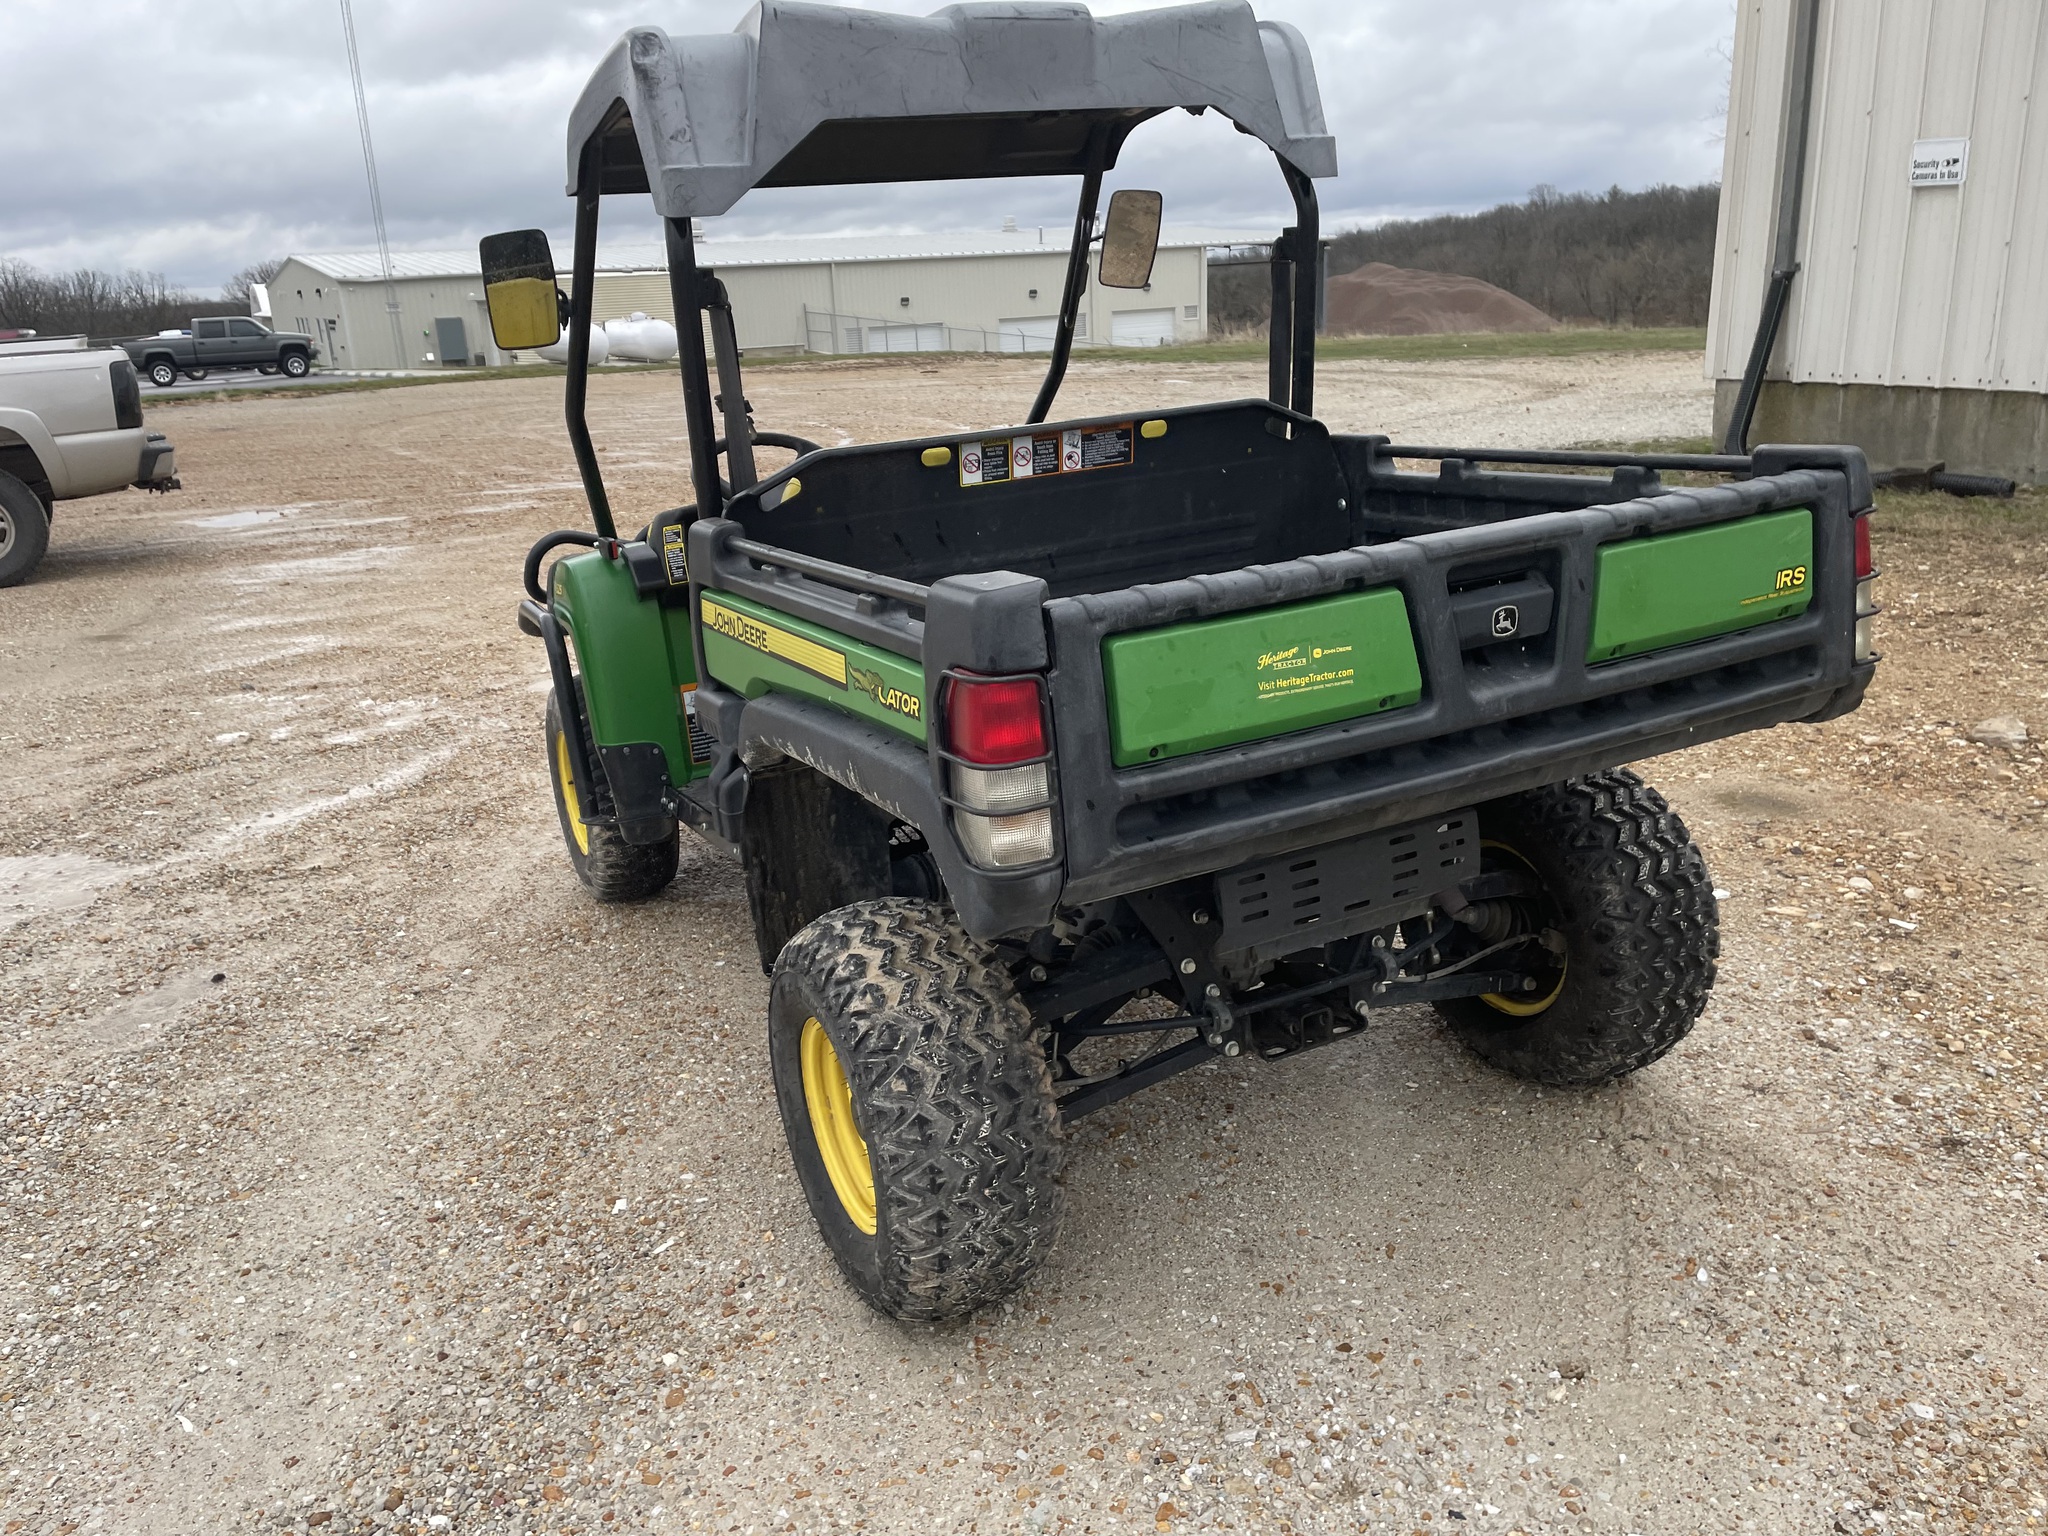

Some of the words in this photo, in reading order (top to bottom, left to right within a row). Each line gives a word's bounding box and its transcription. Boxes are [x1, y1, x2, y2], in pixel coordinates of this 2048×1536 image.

[1912, 171, 1937, 179] Cameras
[1947, 170, 1958, 178] Use
[1913, 160, 1939, 170] Security
[1775, 566, 1806, 589] IRS
[713, 606, 735, 636] JOHN
[736, 615, 768, 649] DEERE
[1256, 646, 1299, 670] Heritage
[1258, 681, 1275, 691] Visit
[1276, 669, 1354, 688] HeritageTractor.com
